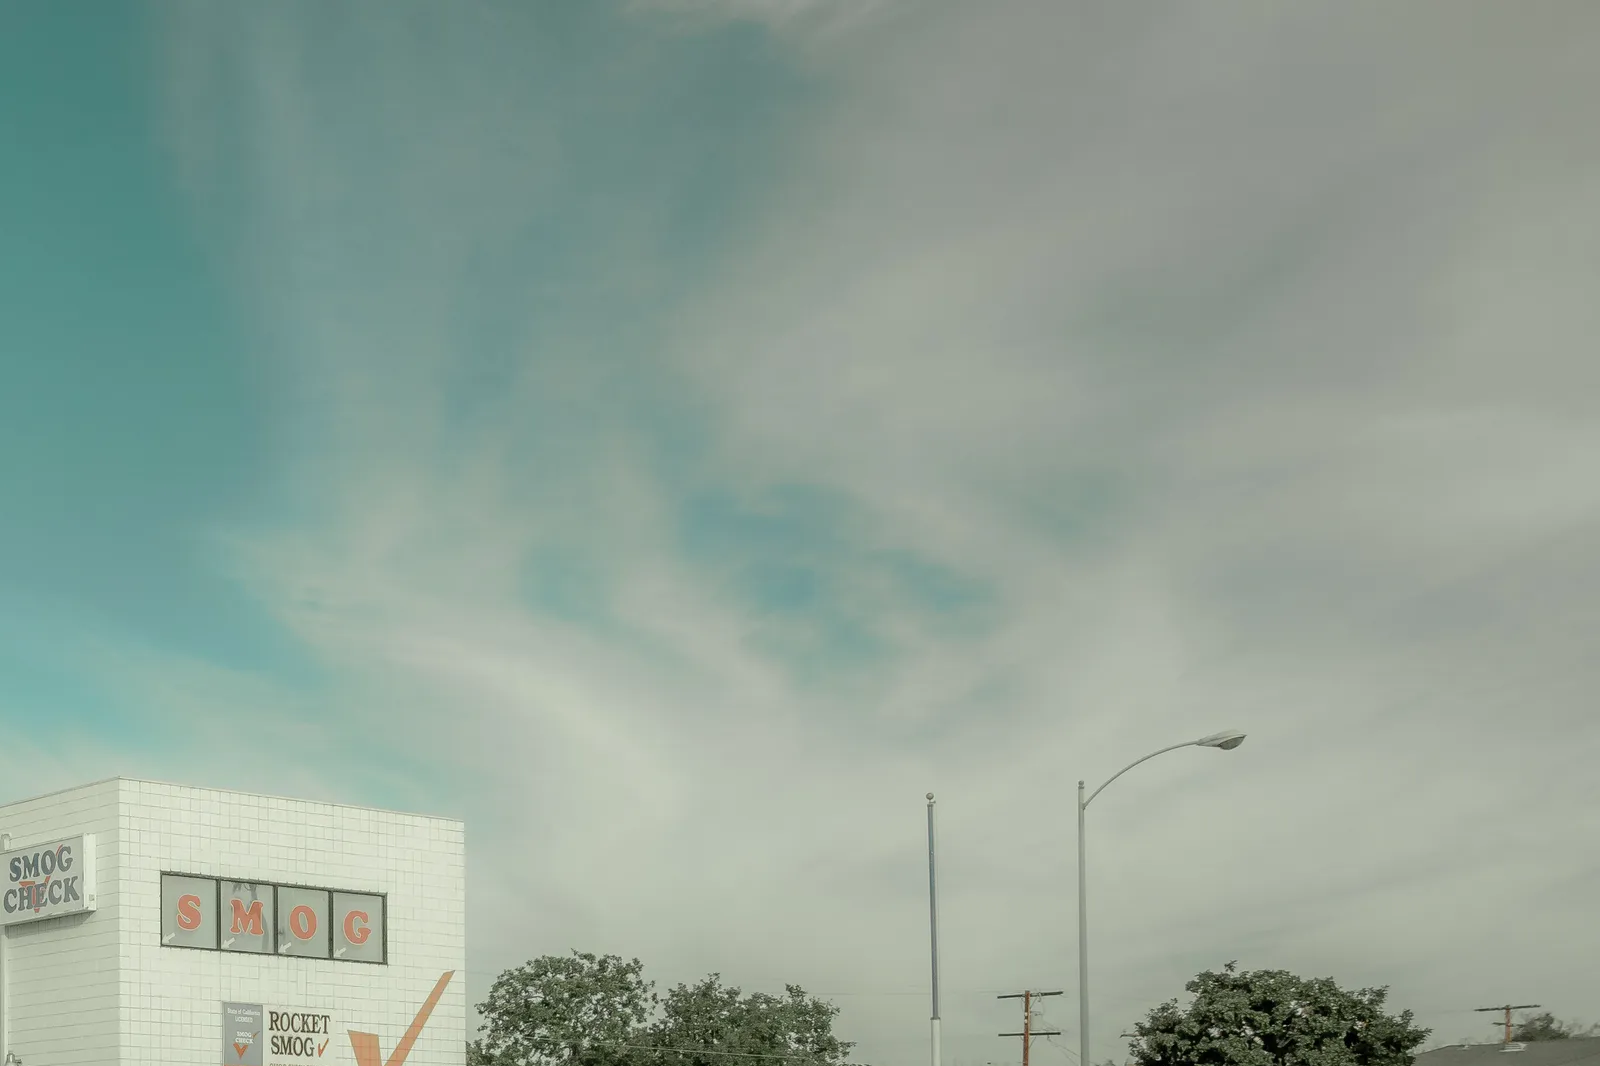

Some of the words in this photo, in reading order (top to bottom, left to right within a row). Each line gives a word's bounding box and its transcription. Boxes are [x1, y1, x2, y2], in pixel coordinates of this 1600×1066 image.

[9, 846, 74, 882] SMOG
[3, 876, 80, 914] CHECK
[176, 894, 372, 945] SMOG
[268, 1011, 331, 1034] ROCKET
[270, 1035, 315, 1057] SMOG
